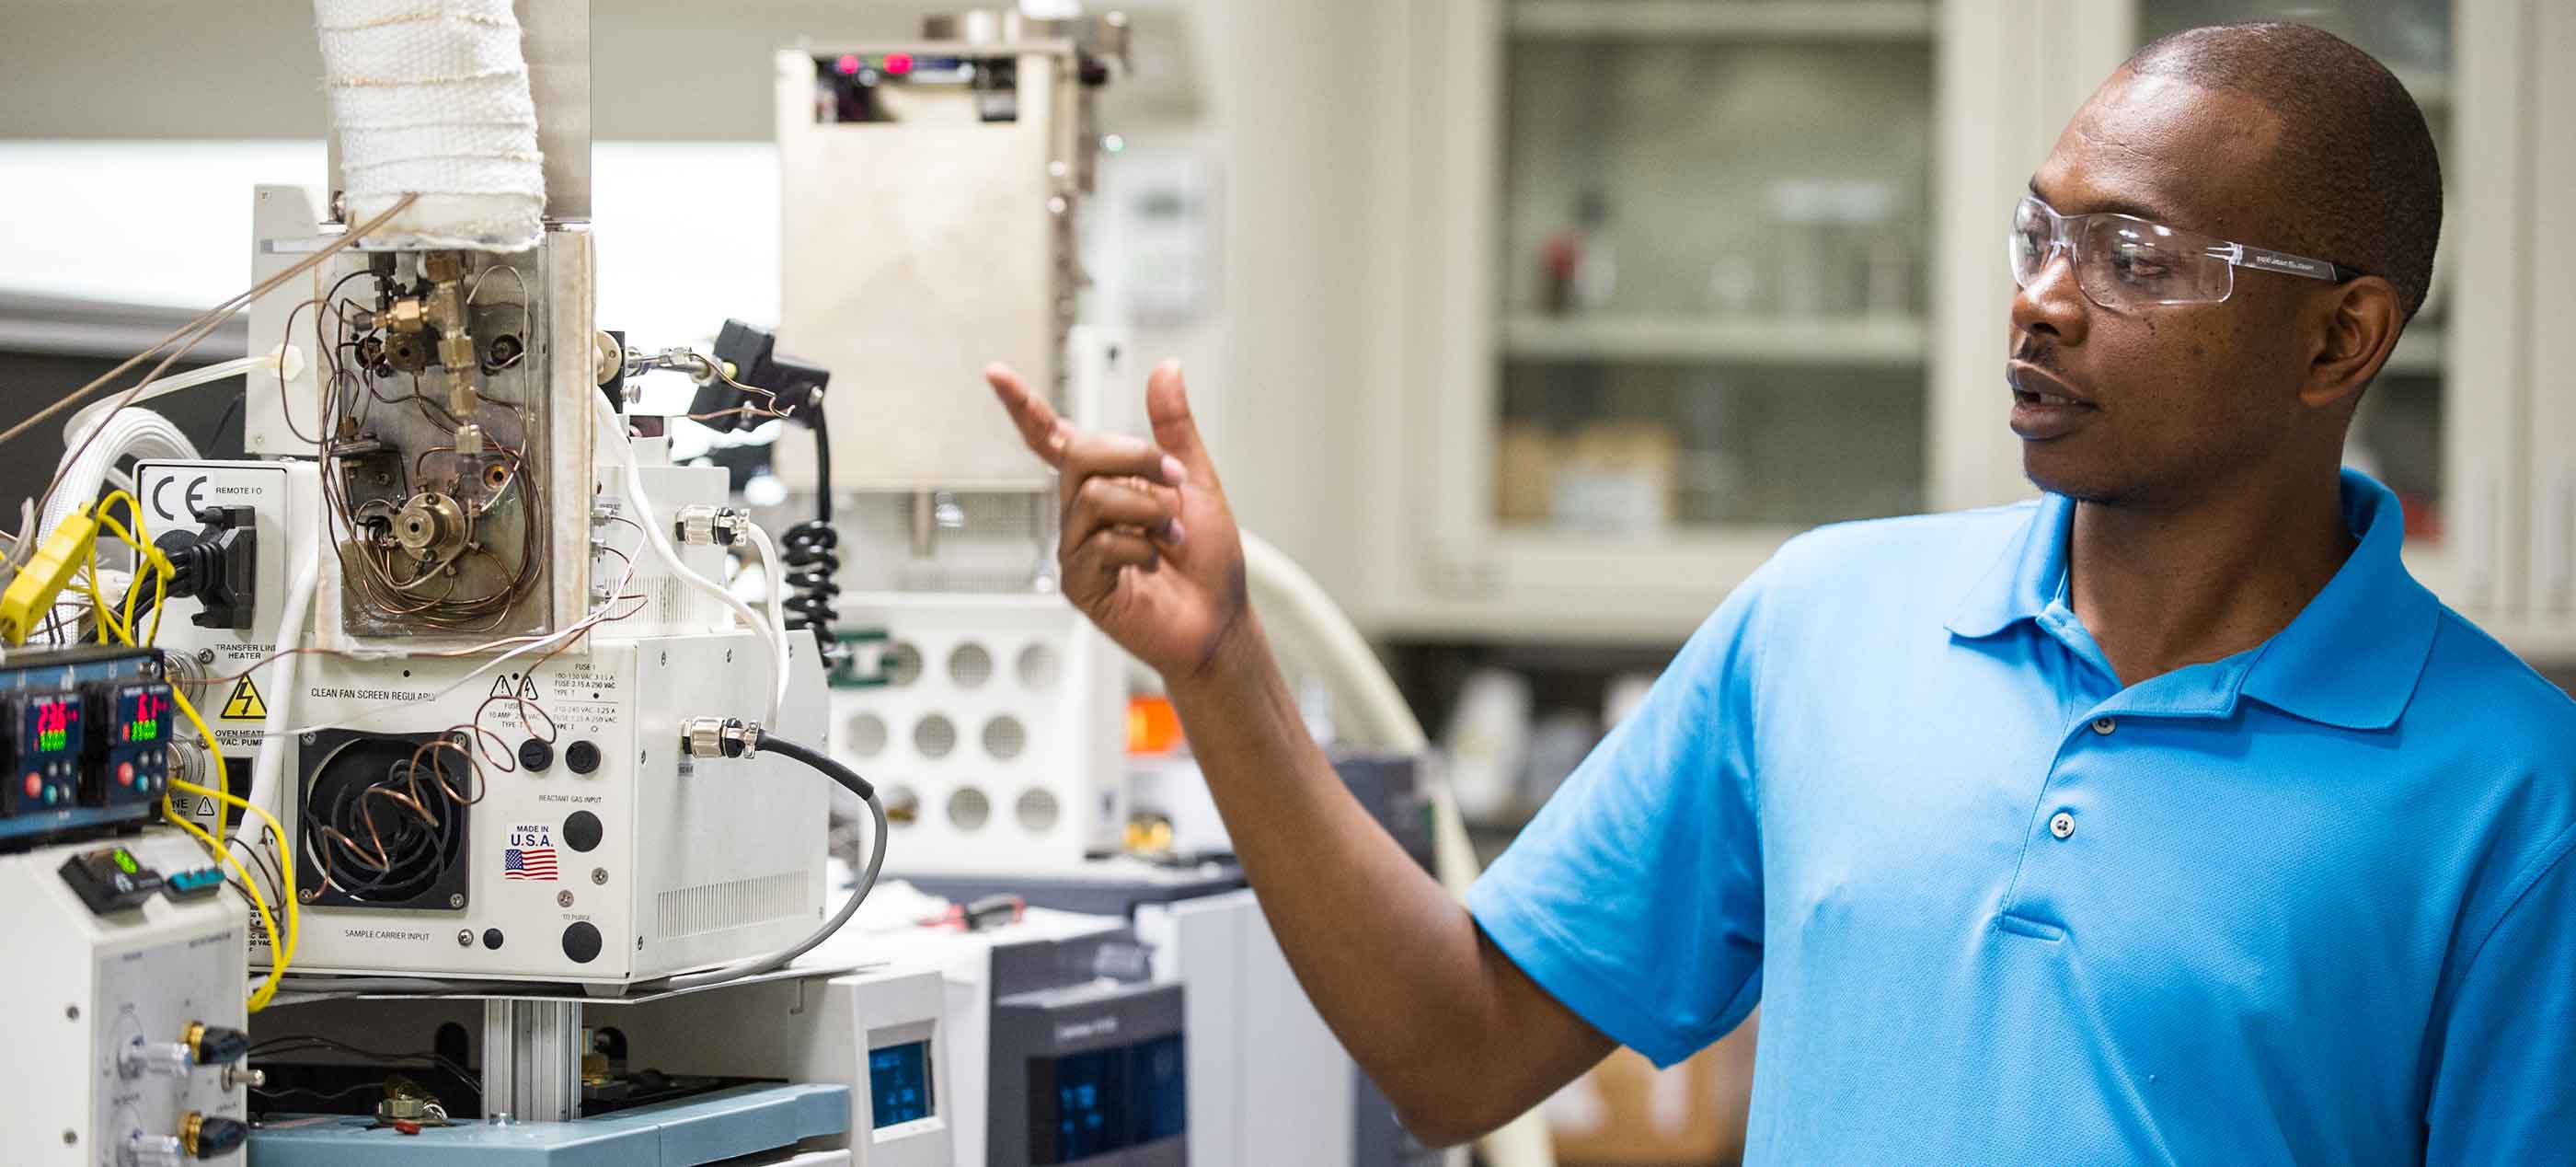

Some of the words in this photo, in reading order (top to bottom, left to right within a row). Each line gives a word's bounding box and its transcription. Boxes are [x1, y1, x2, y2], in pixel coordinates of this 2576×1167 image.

[228, 652, 261, 660] HEATER
[575, 663, 591, 671] FUSE
[311, 687, 337, 698] CLEAN
[339, 688, 355, 699] FAN
[357, 689, 389, 700] SCREEN
[215, 729, 238, 737] OVEN
[539, 794, 569, 803] REACTANT
[516, 825, 539, 833] MADE
[541, 825, 549, 833] IN
[511, 834, 554, 847] U.S.A.
[345, 929, 374, 938] SAMPLE
[375, 930, 407, 940] CARRIER
[408, 932, 431, 941] INPUT
